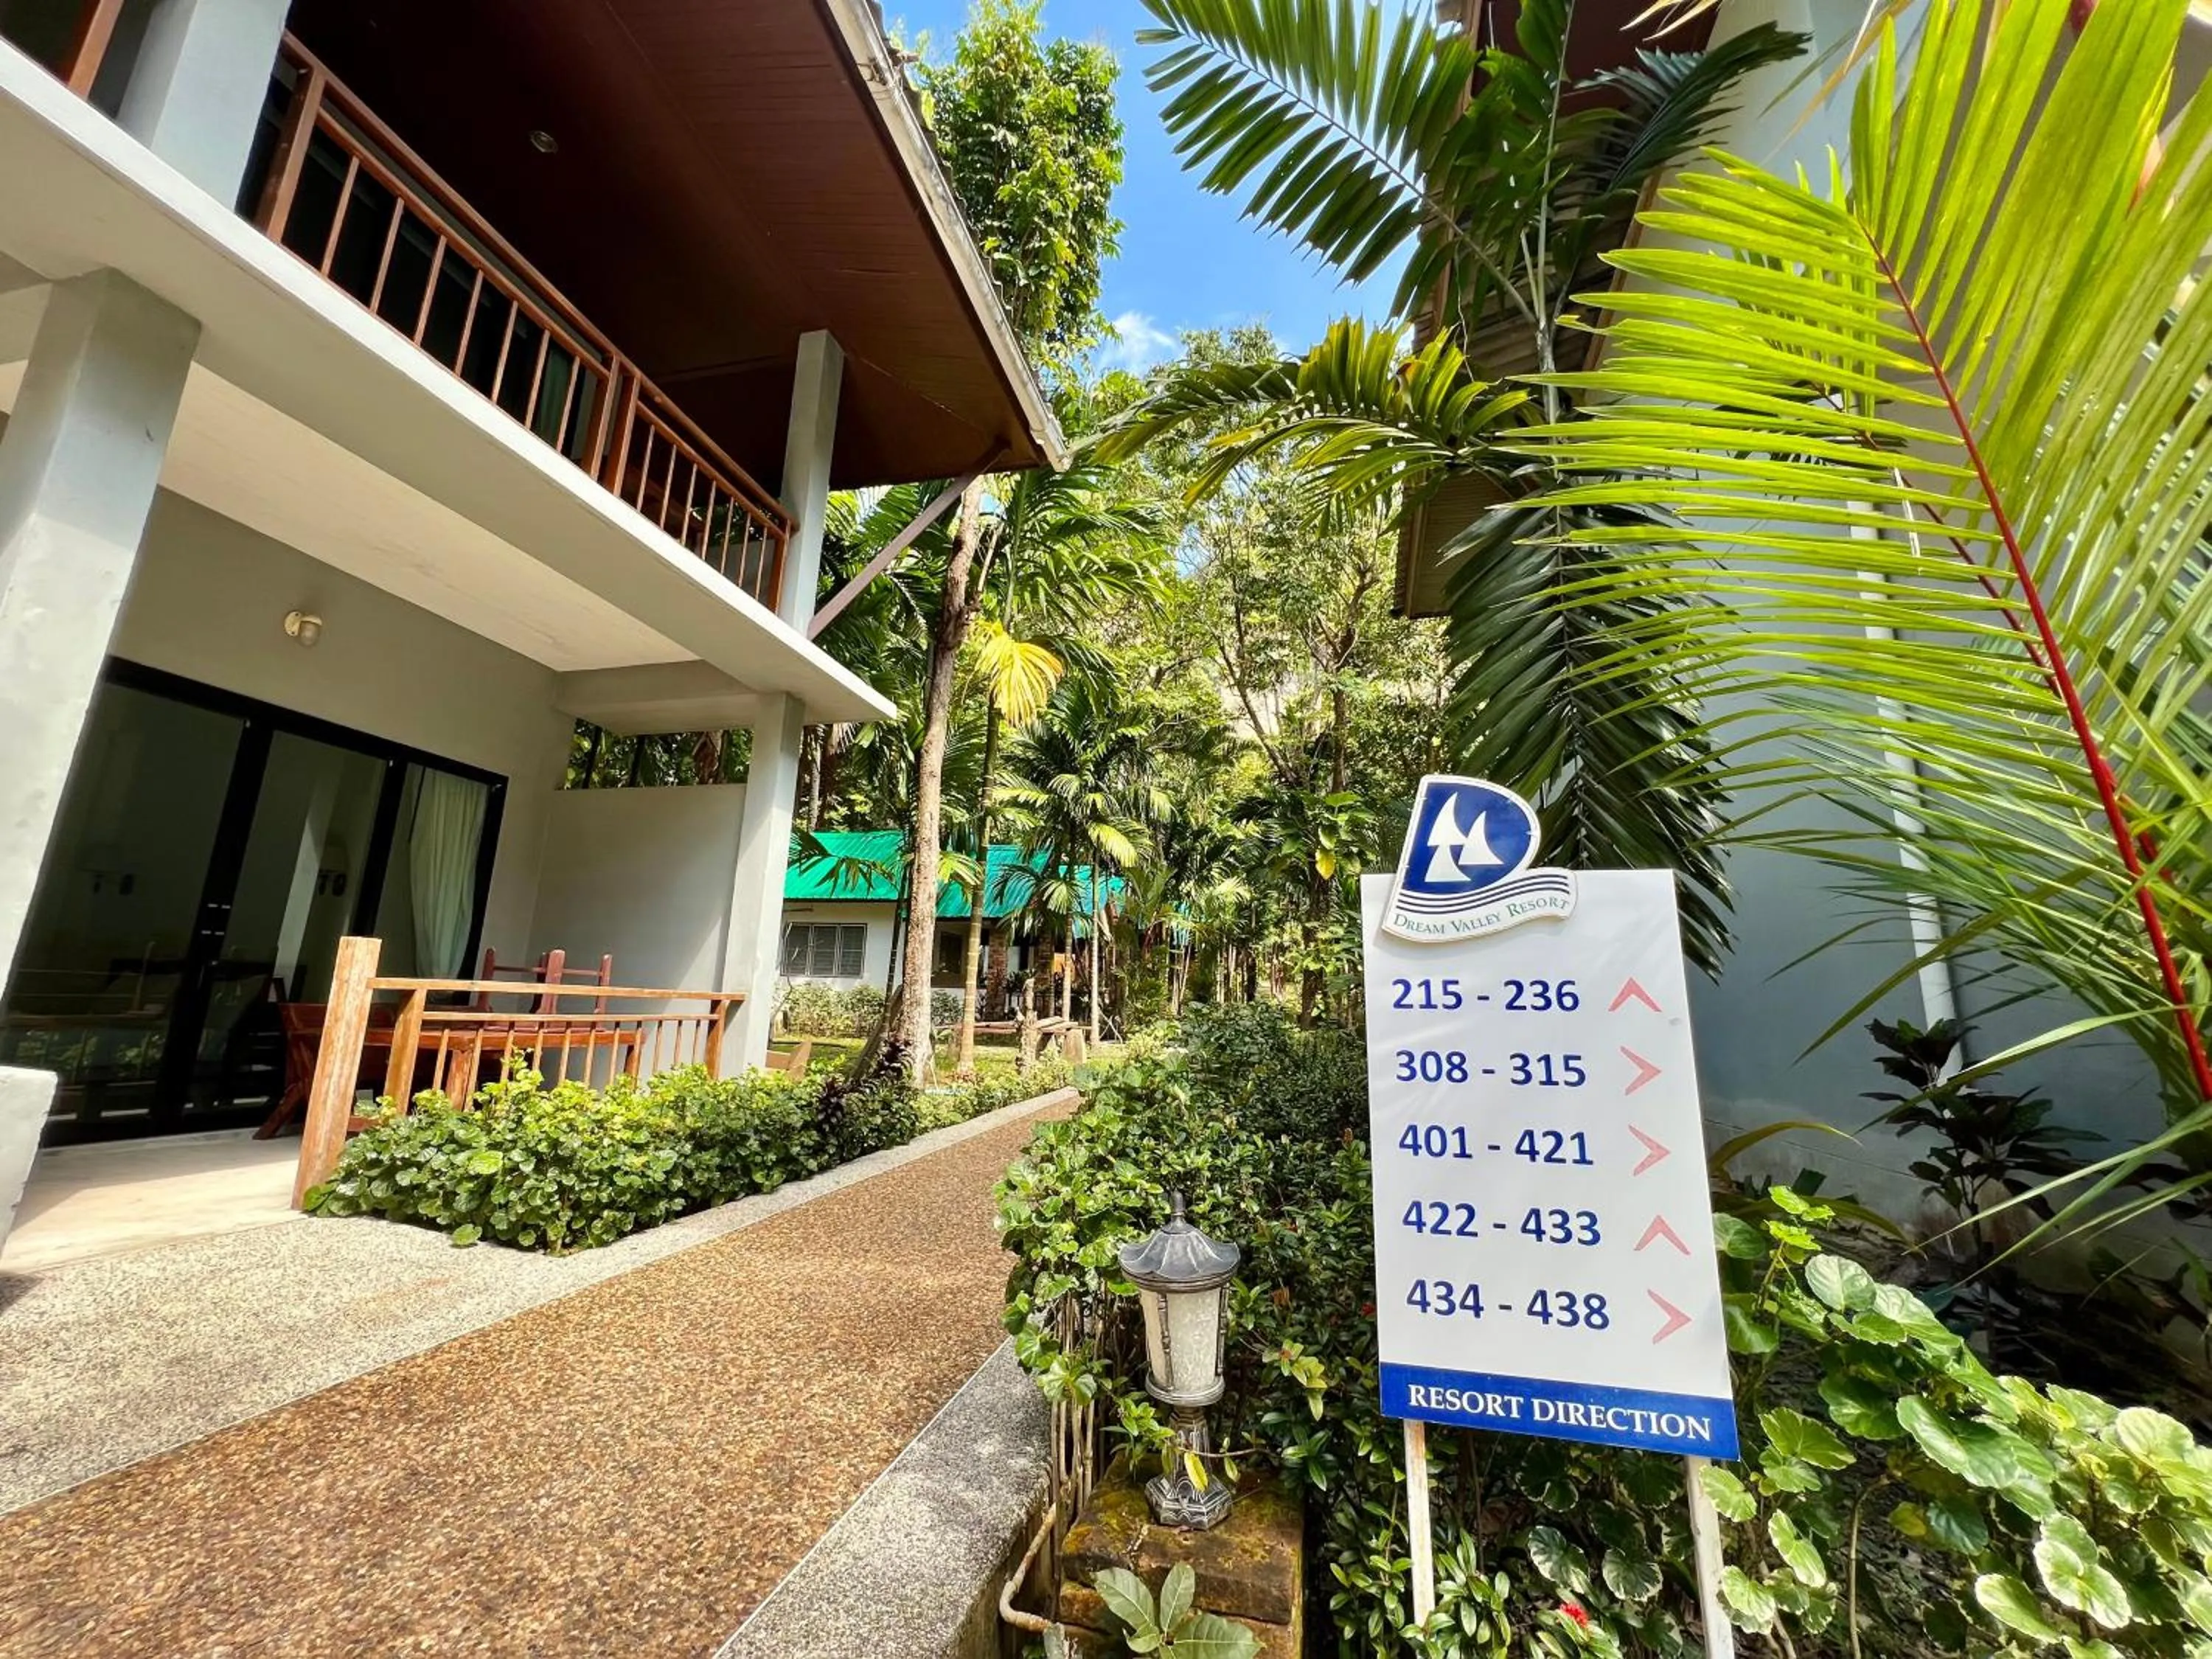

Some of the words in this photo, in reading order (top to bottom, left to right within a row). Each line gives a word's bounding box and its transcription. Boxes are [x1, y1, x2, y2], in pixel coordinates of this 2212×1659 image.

[1394, 914, 1445, 935] DREAM
[1451, 913, 1501, 933] VALLEY
[1506, 898, 1569, 917] RESORT
[1392, 979, 1463, 1009] 215
[1503, 980, 1580, 1011] 236
[1396, 1050, 1469, 1083] 308
[1509, 1053, 1586, 1086] 315
[1399, 1124, 1472, 1158] 401
[1514, 1130, 1593, 1165] 421
[1402, 1200, 1478, 1237] 422
[1520, 1208, 1601, 1246] 433
[1406, 1279, 1484, 1318] 434
[1526, 1290, 1610, 1329] 438
[1408, 1384, 1524, 1418] RESORT
[1531, 1399, 1711, 1441] DIRECTION
